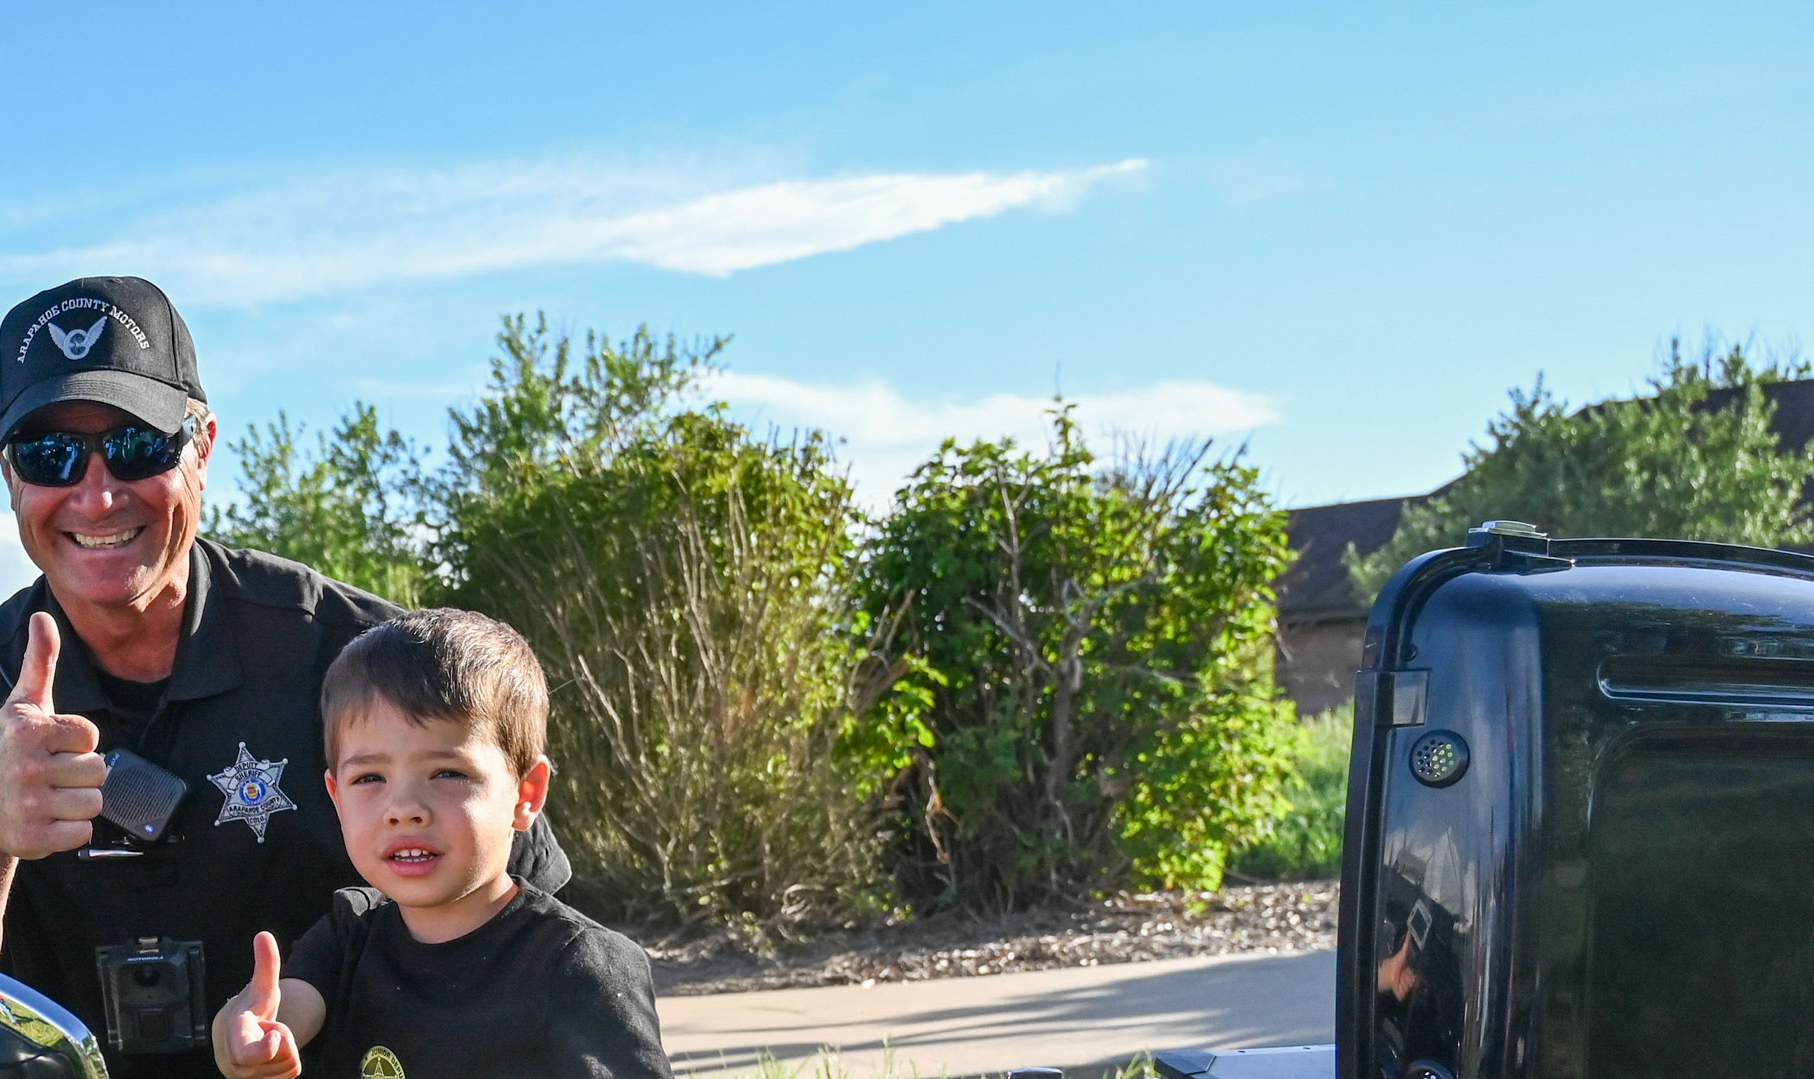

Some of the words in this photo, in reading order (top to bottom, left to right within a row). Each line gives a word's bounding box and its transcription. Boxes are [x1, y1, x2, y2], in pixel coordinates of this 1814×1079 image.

[17, 303, 61, 364] ARAPAHOE
[61, 297, 110, 314] COUNTY
[108, 305, 150, 351] MOTORS
[235, 761, 258, 772] DEPUTY
[235, 770, 263, 781] SHERIFF
[371, 1048, 391, 1060] JUNIOR
